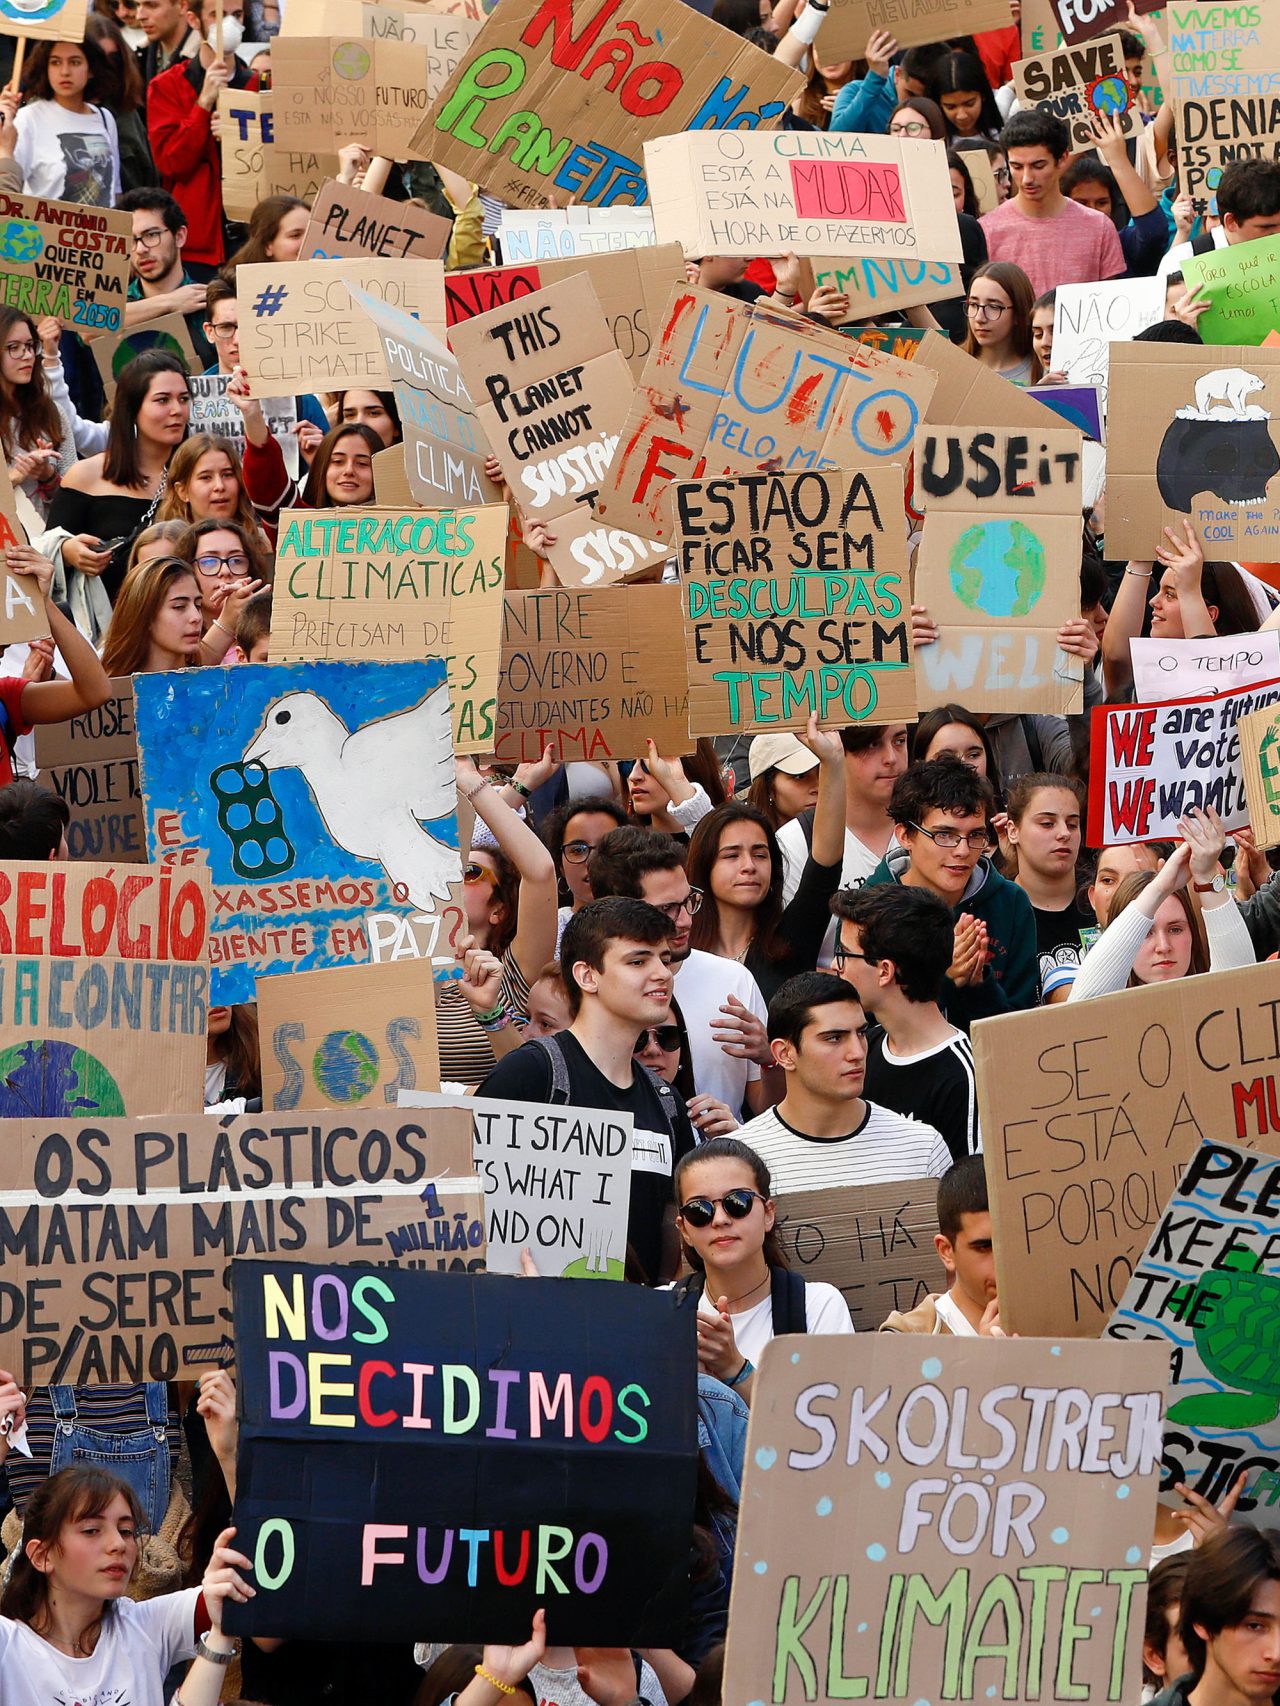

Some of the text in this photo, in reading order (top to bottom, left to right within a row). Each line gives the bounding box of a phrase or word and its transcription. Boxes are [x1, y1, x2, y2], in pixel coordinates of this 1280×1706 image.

[1173, 6, 1261, 29] VIVEMOS
[1024, 43, 1115, 101] SAVE
[1173, 49, 1243, 72] COMO SE
[314, 86, 428, 109] NOSSO FUTURO
[436, 47, 648, 207] PLANETA
[717, 133, 868, 160] O CLIMA
[1183, 145, 1211, 168] IS
[1219, 142, 1266, 164] NOT
[702, 160, 904, 219] ESTÁ A MUDAR
[707, 185, 793, 210] ESTÁ NA
[322, 203, 424, 259] PLANET
[712, 220, 917, 247] HORA DE O FAZERMOS
[35, 263, 122, 294] VIVER NA
[44, 245, 104, 270] QUERO
[73, 300, 121, 331] 2050
[76, 289, 95, 302] EM
[1060, 293, 1131, 335] NÃO
[255, 321, 356, 350] STRIKE
[490, 305, 561, 361] THIS
[258, 351, 382, 380] CLIMATE
[385, 336, 471, 403] POLÍTICA
[678, 304, 919, 456] LUTO
[507, 403, 593, 460] CANNOT
[708, 412, 776, 460] PELO
[416, 440, 483, 502] CLIMA
[676, 470, 832, 536] ESTÃO
[787, 530, 875, 571] SEM
[1203, 525, 1280, 539] COOL AGAIN
[288, 555, 503, 600] CLIMÁTICAS
[688, 575, 902, 620] DESCULPAS
[291, 612, 455, 648] PRECISAM DE
[695, 614, 909, 670] E NÓS SEM
[1158, 656, 1178, 672] O
[1191, 651, 1264, 672] TEMPO
[620, 692, 653, 719] NÃO
[712, 669, 879, 725] TEMPO
[494, 726, 612, 764] CLIMA
[1109, 705, 1215, 768] WE are
[1108, 776, 1156, 837] WE
[394, 881, 409, 902] O
[331, 927, 367, 957] EM
[48, 960, 208, 1036] CONTAR
[1031, 1035, 1111, 1111] SE
[34, 1125, 111, 1198] OS
[134, 1115, 427, 1196] PLÁSTICOS
[530, 1115, 627, 1158] STAND
[1003, 1092, 1147, 1181] ESTÁ
[504, 1161, 582, 1202] WHAT
[0, 1193, 384, 1268] MATAM MAIS DE
[385, 1212, 485, 1258] MILHÃO
[536, 1213, 585, 1250] ON
[855, 1201, 918, 1262] HÁ
[0, 1279, 63, 1333] DE
[1133, 1270, 1222, 1330] THE
[23, 1325, 180, 1386] P/ANO
[269, 1350, 652, 1444] DECIDIMOS
[897, 1472, 1046, 1557] FÖR
[360, 1523, 609, 1595] FUTURO
[771, 1564, 1150, 1705] KLIMATET
